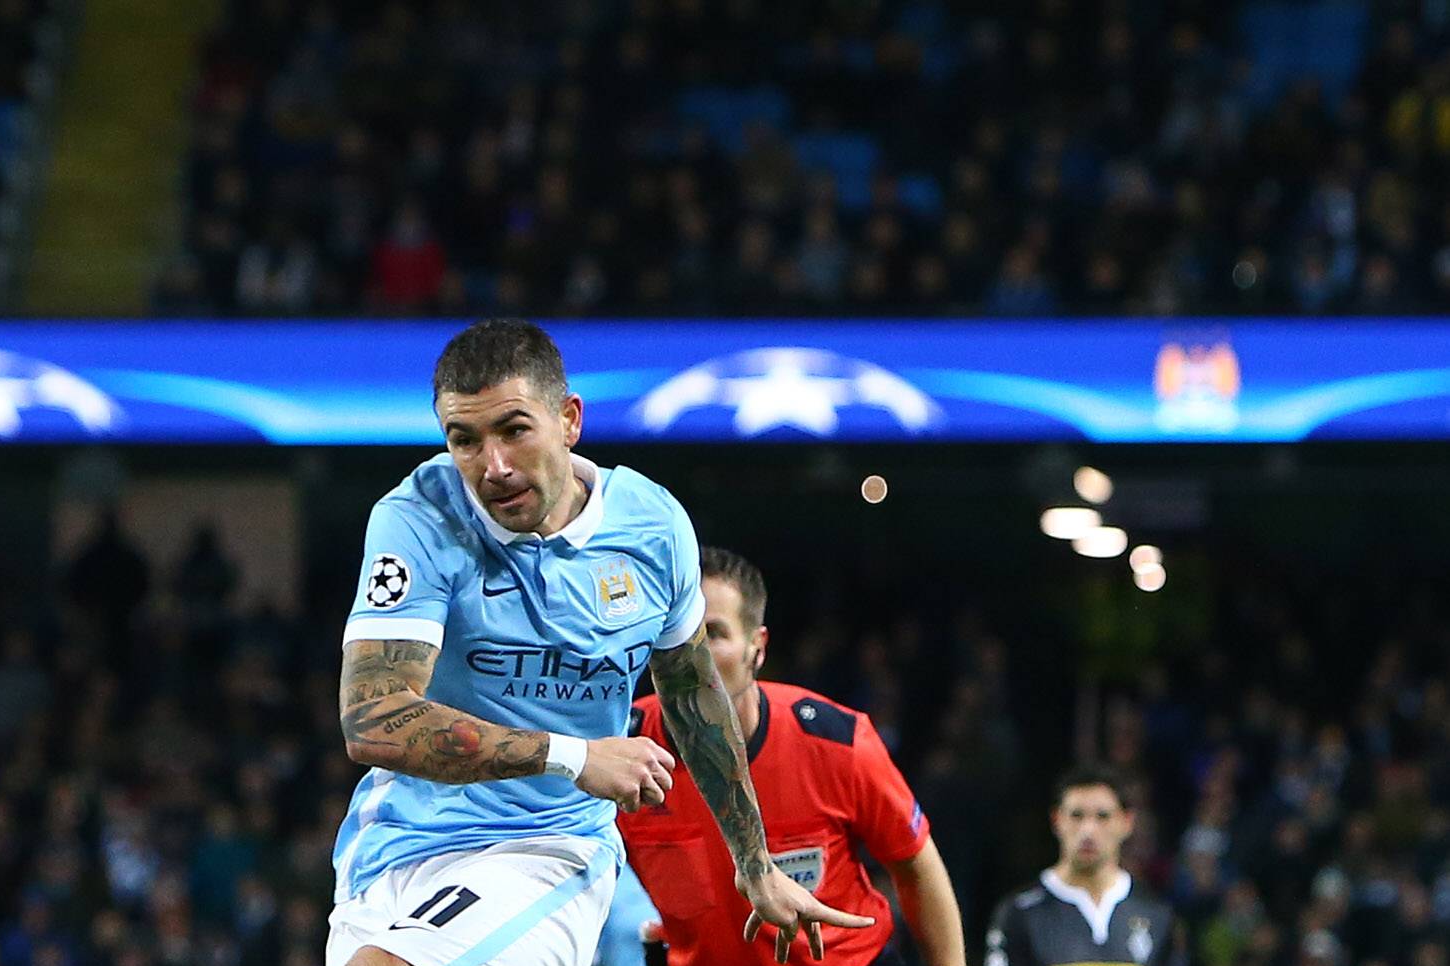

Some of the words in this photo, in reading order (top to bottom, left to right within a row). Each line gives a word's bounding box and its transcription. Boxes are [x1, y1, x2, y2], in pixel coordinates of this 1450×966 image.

[466, 641, 652, 681] ETIHAD
[502, 682, 627, 700] AIRWAYS
[408, 885, 481, 928] 11
